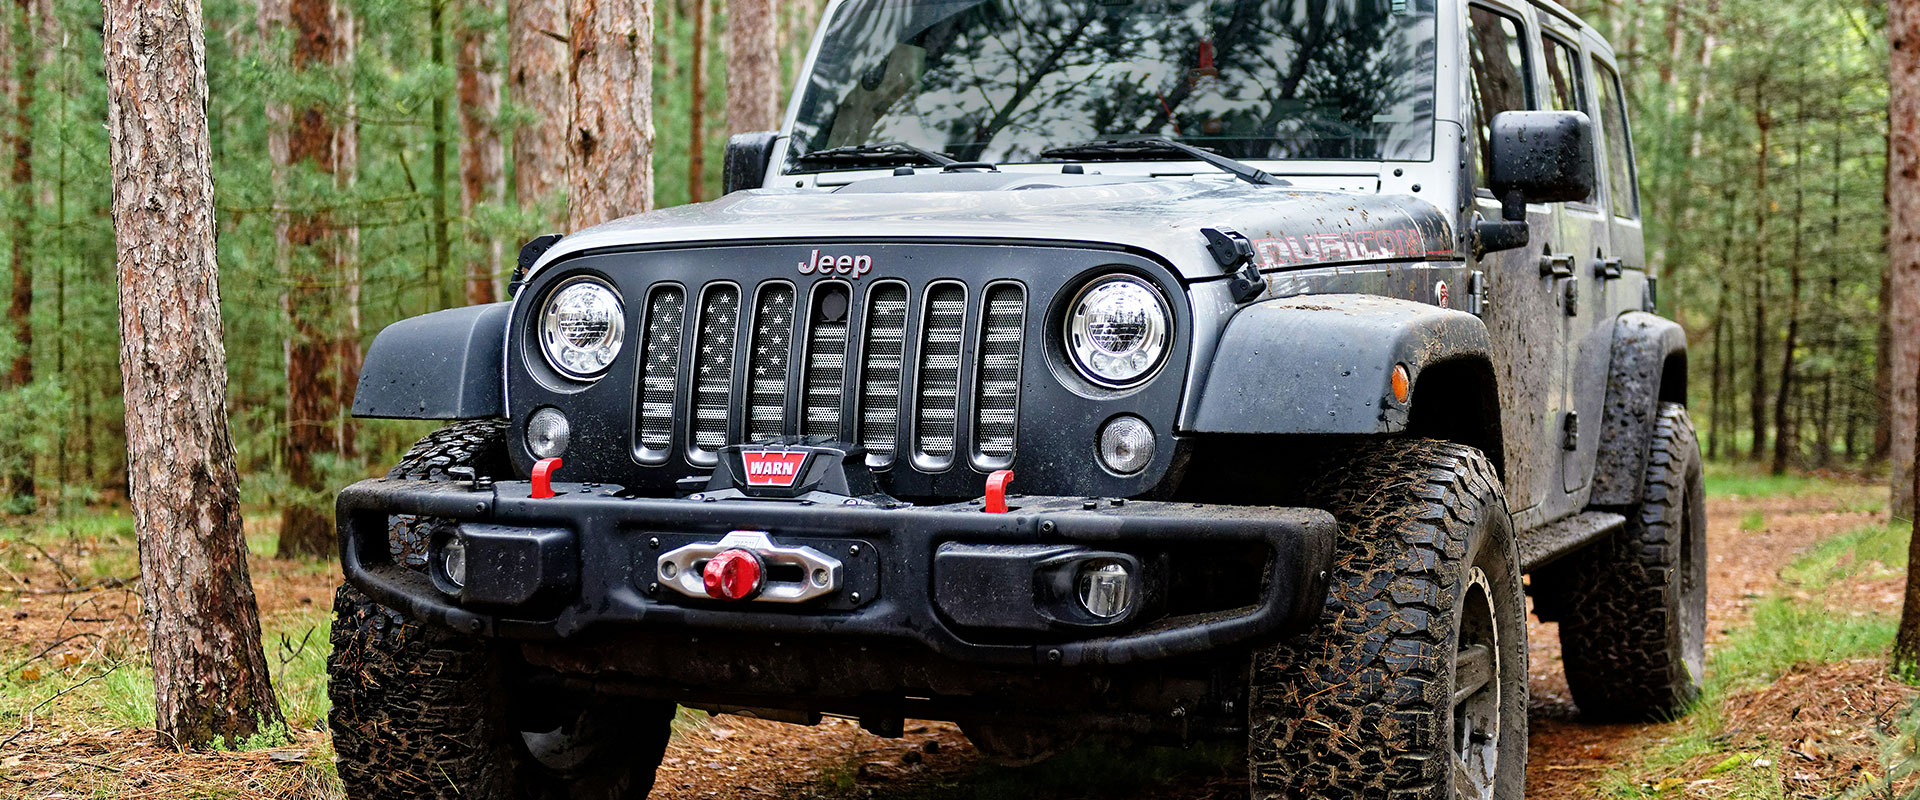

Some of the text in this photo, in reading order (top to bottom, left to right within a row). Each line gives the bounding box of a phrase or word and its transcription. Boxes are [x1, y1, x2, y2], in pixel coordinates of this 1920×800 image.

[1253, 228, 1422, 267] RUBICON
[798, 249, 872, 280] Jeep
[750, 461, 794, 476] WARN
